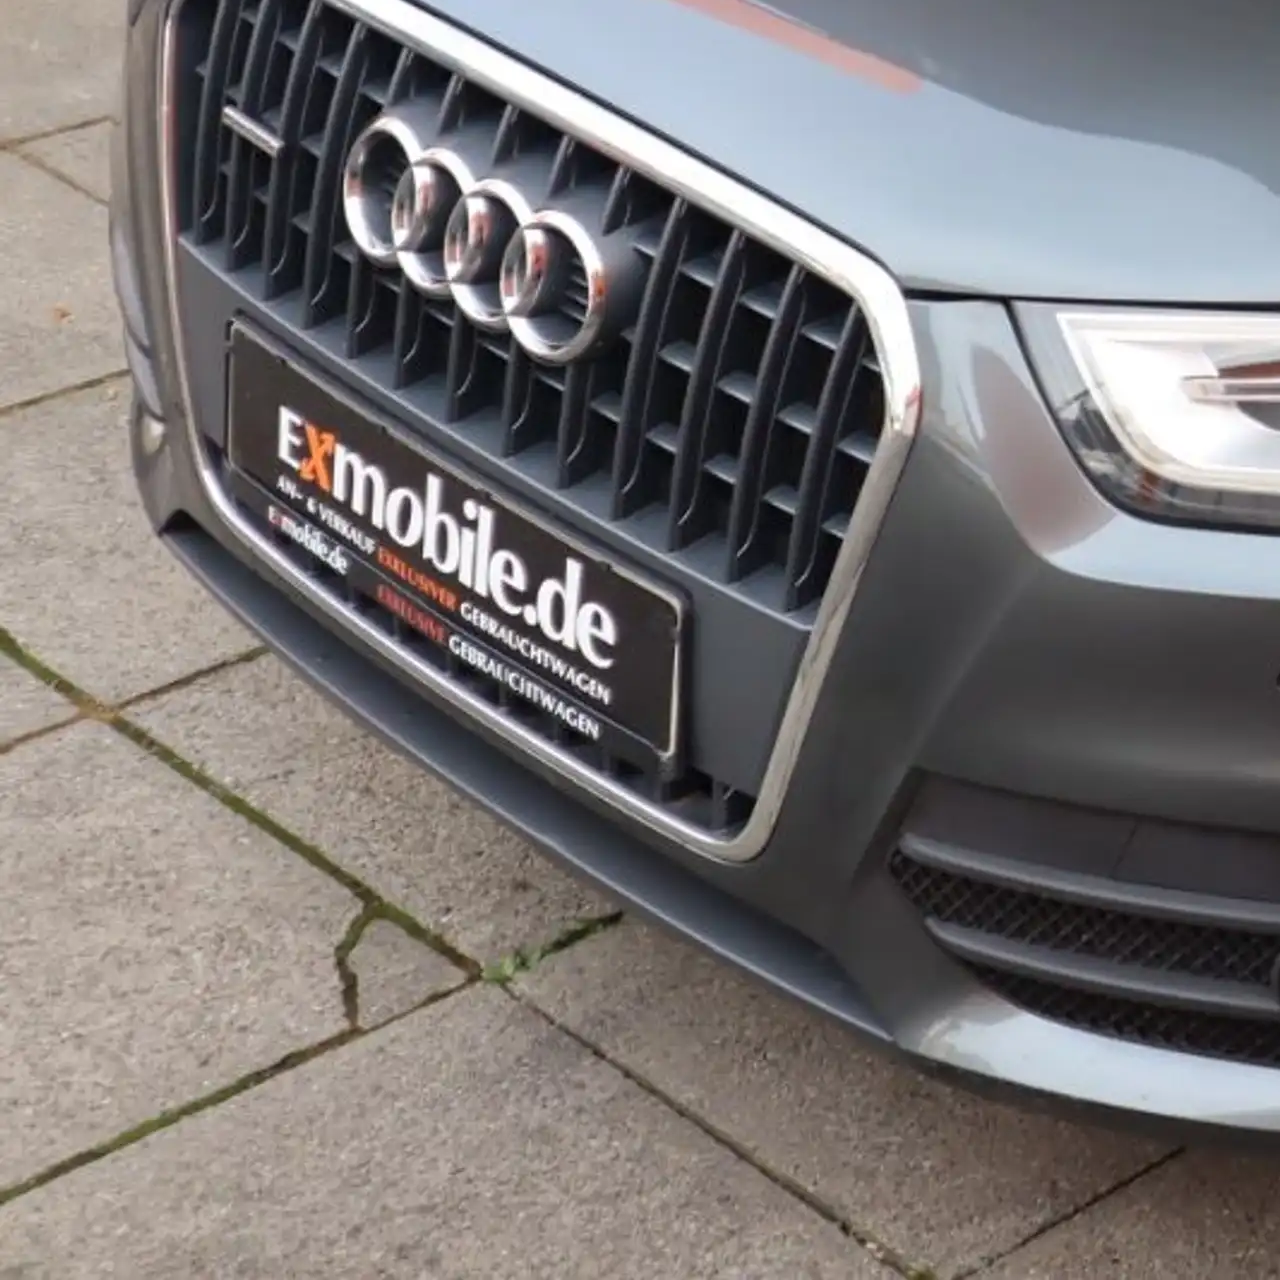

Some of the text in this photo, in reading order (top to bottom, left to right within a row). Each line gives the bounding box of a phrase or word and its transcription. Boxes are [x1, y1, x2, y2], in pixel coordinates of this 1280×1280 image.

[276, 405, 617, 669] EXmobile.de
[448, 634, 599, 741] GEBRAUCHTWAGEN
[460, 601, 611, 705] GEBRAUCHTWAGEN
